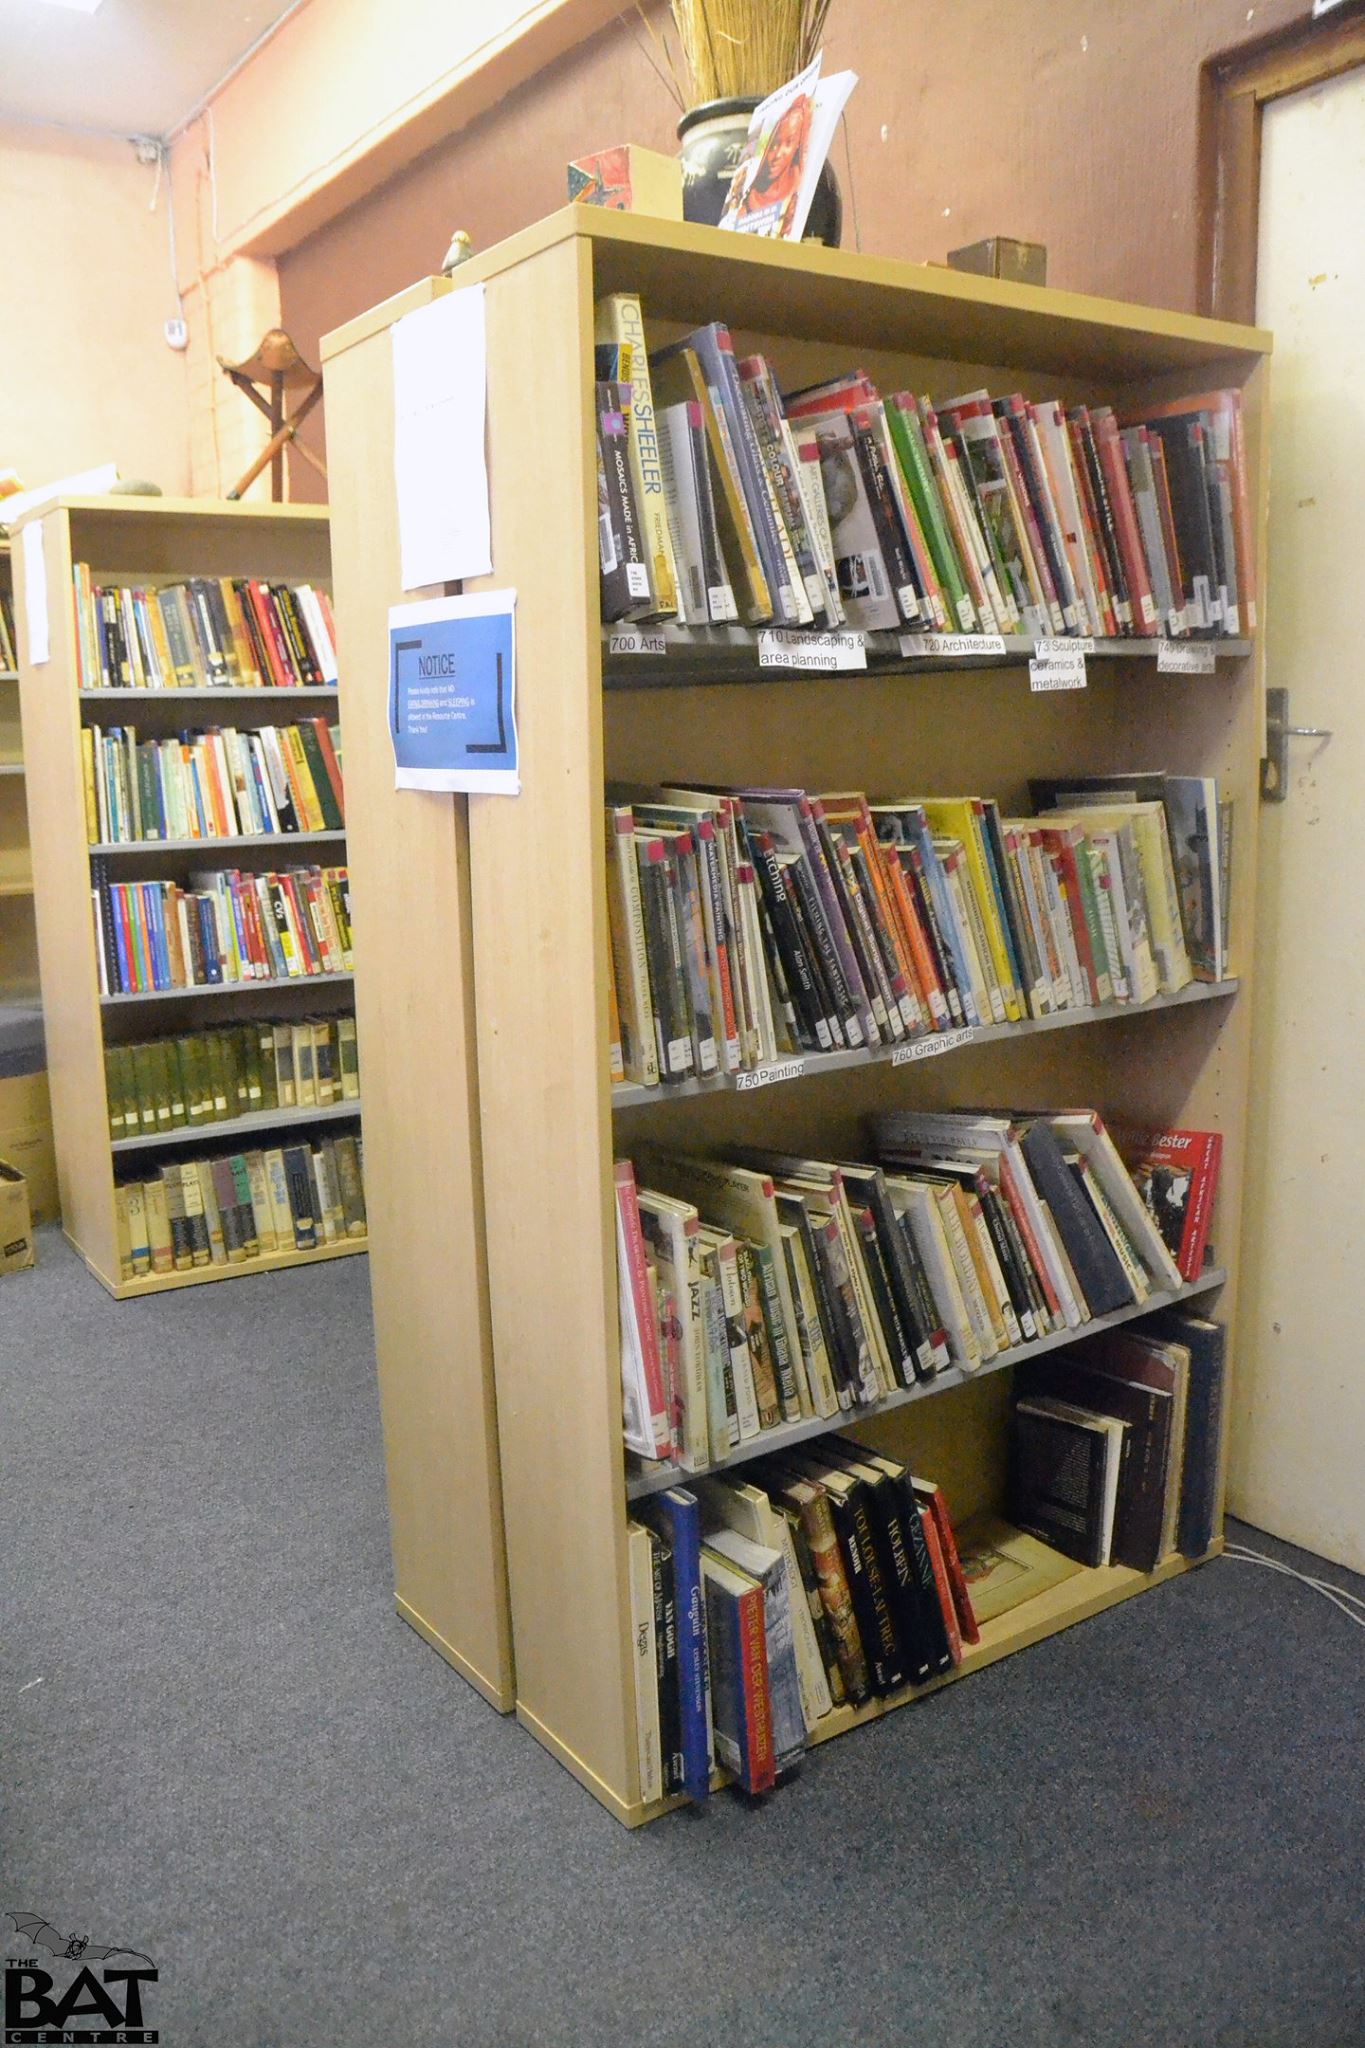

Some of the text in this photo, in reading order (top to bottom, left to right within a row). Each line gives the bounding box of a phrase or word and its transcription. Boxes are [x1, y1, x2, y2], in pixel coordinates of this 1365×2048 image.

[618, 301, 649, 403] CHARLES
[632, 400, 662, 494] SHEELER
[763, 442, 786, 486] COLOUR
[612, 449, 638, 562] MOSAICS MADE in AFRIC
[611, 636, 666, 651] 700 Arts
[786, 632, 854, 650] Landscaping
[857, 634, 864, 648] &
[943, 639, 1001, 651] Architecture
[1052, 640, 1093, 653] Sculpture
[418, 653, 456, 677] NOTICE
[760, 652, 838, 669] area planning
[1031, 657, 1084, 671] ceramics &
[1032, 676, 1082, 689] metalwork
[705, 840, 720, 900] WATERMEDIA
[762, 846, 788, 903] Etching
[629, 885, 646, 969] COMPOSITION
[712, 900, 725, 943] PAINTING
[851, 891, 872, 933] Digital
[791, 948, 814, 991] Alan Smith
[893, 1028, 974, 1063] 760 Graphic arts
[738, 1063, 804, 1088] 750 Painting
[1152, 1133, 1192, 1151] Bester
[991, 1216, 1012, 1262] Choral Music
[1112, 1238, 1134, 1270] MUSIC
[761, 1262, 779, 1297] African
[767, 1296, 784, 1325] Music
[774, 1336, 791, 1365] Ghana
[846, 1534, 863, 1575] RENOIR
[886, 1518, 911, 1587] HOLBEIN
[853, 1503, 896, 1657] TOULOUSE-LAUTREC
[662, 1599, 676, 1658] VAN GOGH
[686, 1585, 703, 1637] Gauguin
[636, 1621, 650, 1657] Degas
[748, 1636, 762, 1662] VAN
[750, 1661, 764, 1689] DER
